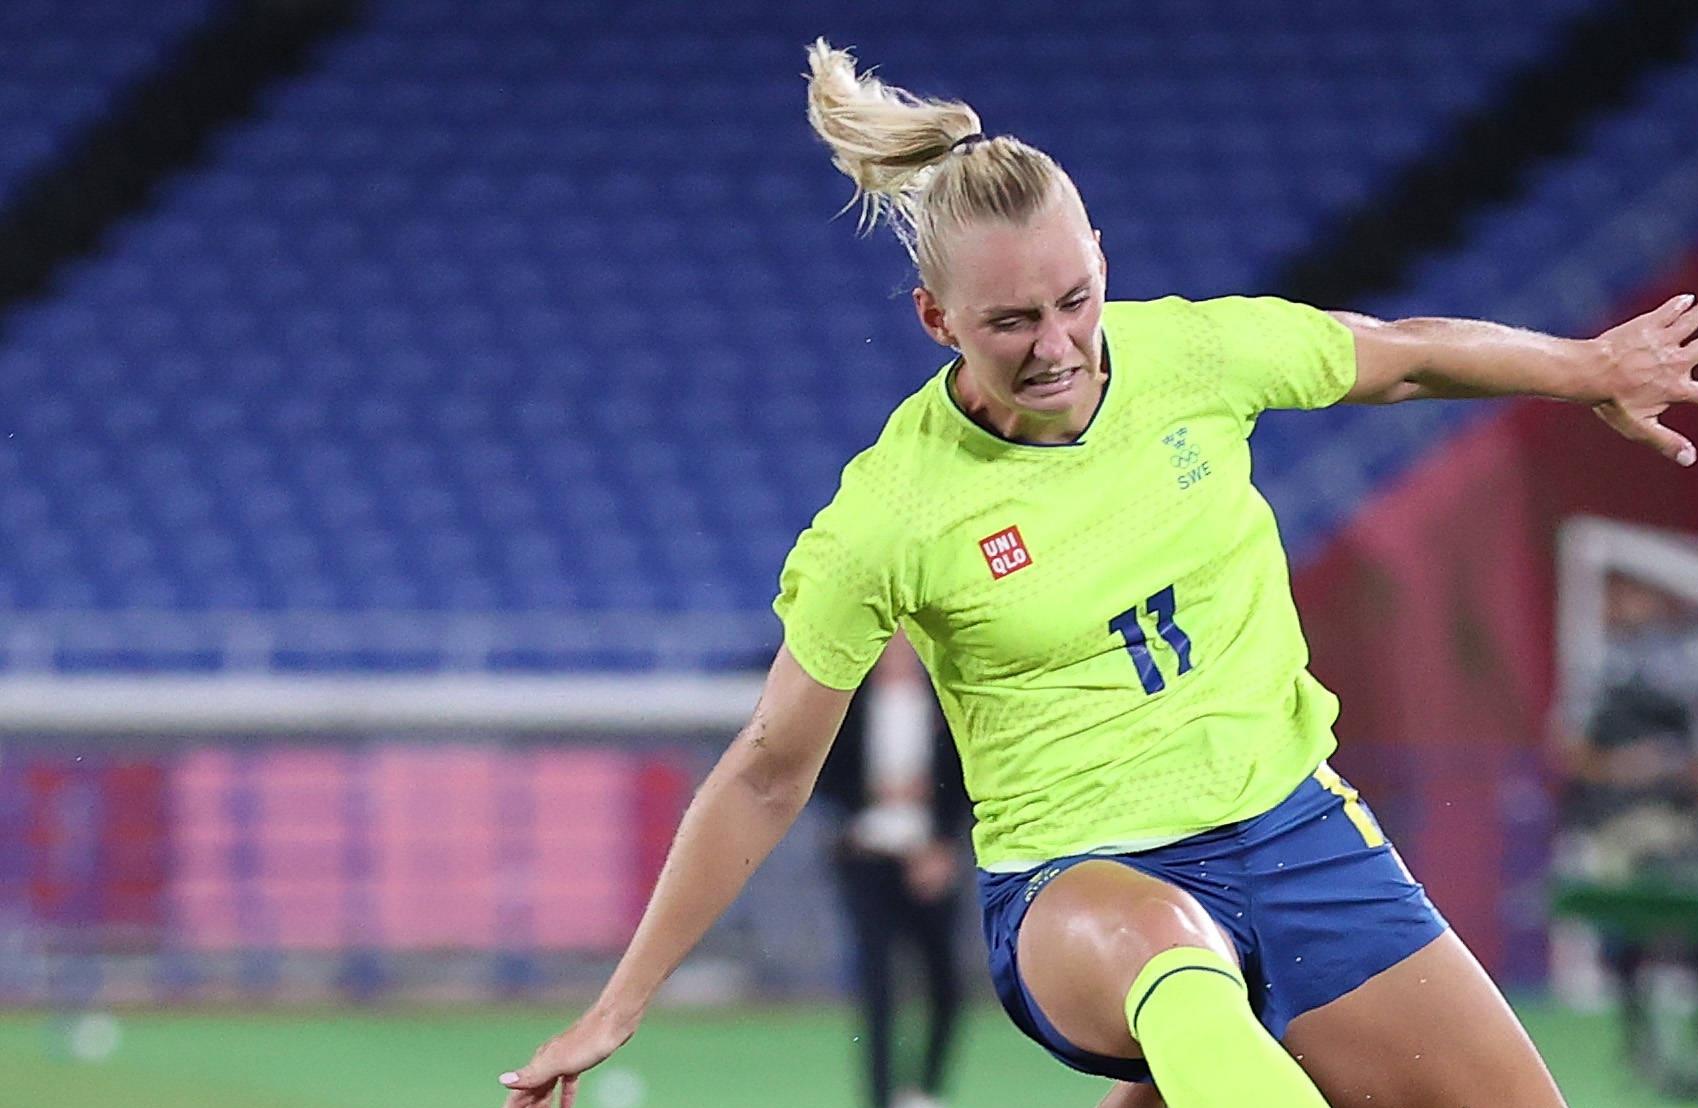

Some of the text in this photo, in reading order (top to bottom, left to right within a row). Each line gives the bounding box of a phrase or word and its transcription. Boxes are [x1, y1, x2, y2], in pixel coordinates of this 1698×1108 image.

[1177, 460, 1212, 490] SWE
[982, 531, 1018, 558] UNI
[991, 547, 1027, 575] QLO
[1107, 583, 1194, 696] 11
